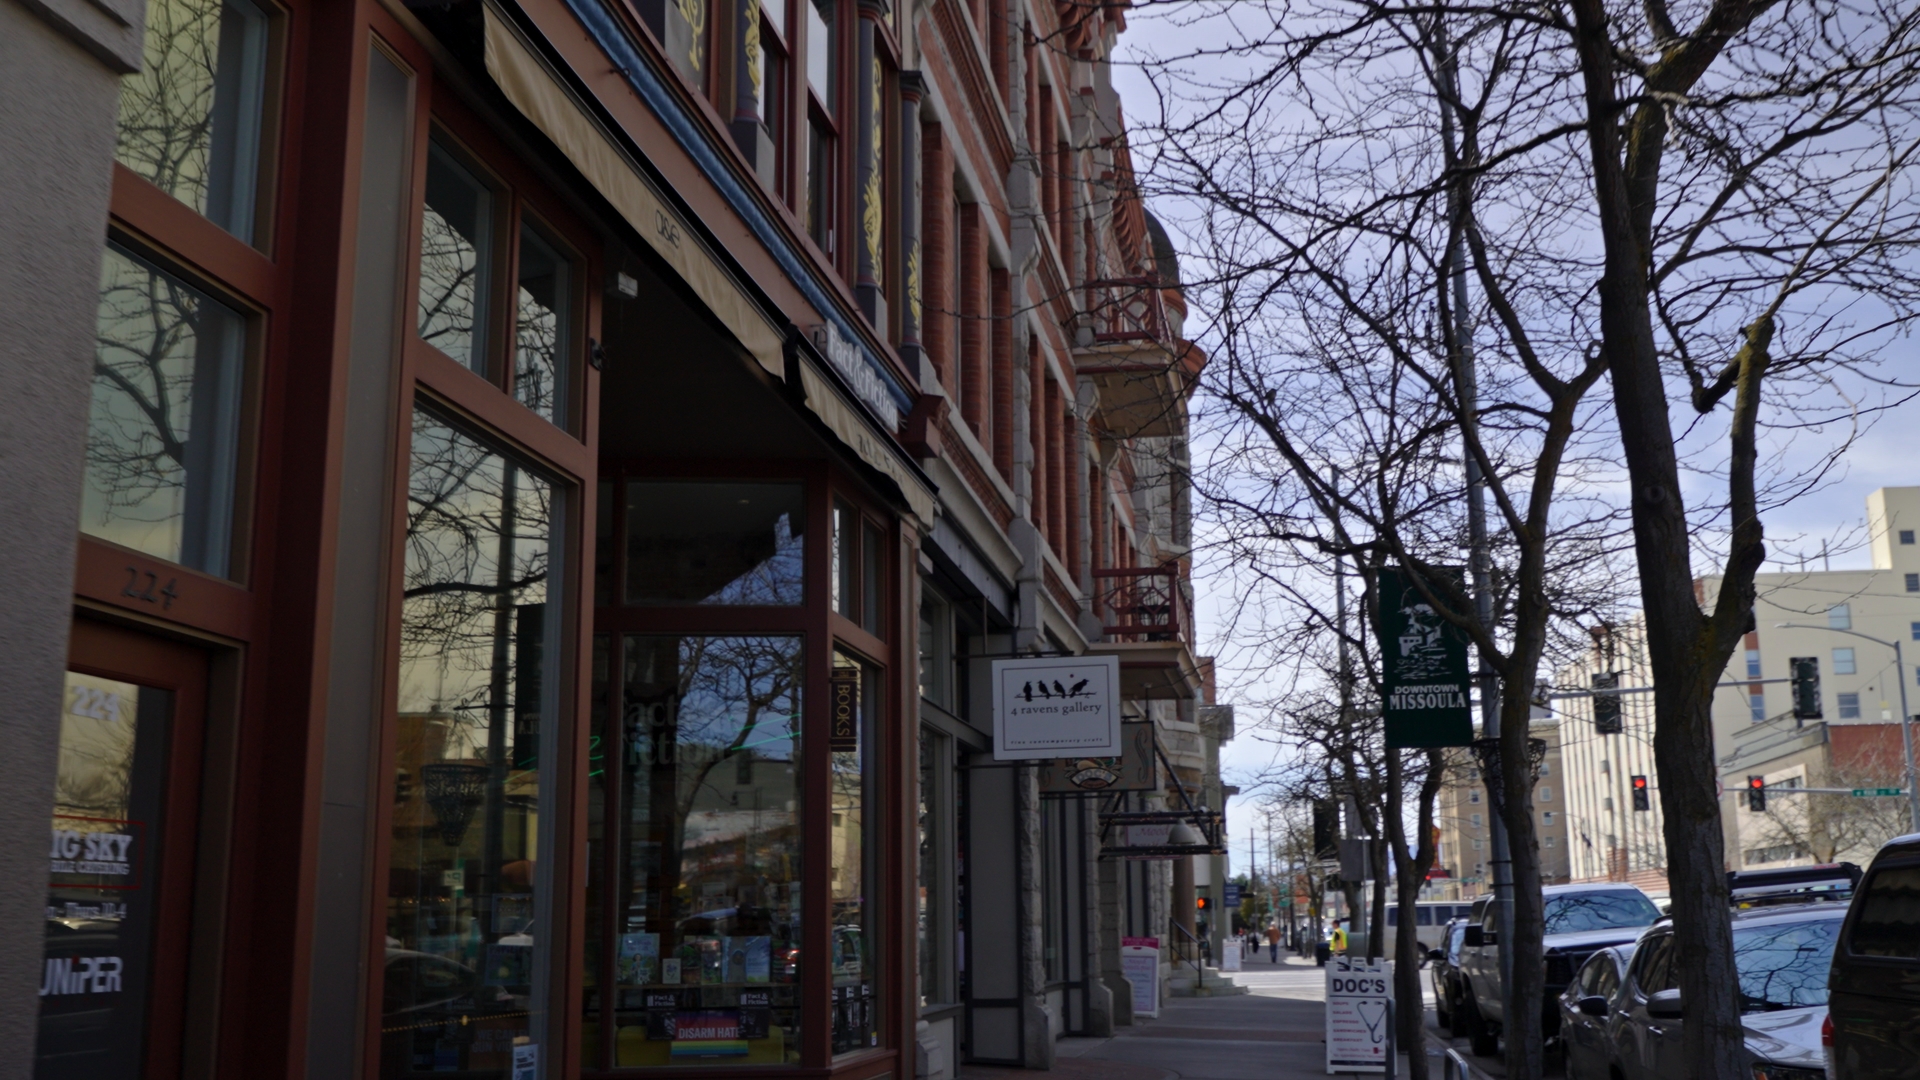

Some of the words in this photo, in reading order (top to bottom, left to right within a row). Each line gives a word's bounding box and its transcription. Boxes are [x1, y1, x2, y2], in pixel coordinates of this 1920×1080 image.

[827, 325, 853, 377] Fact
[853, 348, 864, 391] &
[864, 366, 899, 431] Fiction
[121, 565, 179, 611] 224
[71, 685, 120, 723] 224
[1389, 692, 1467, 711] MISSOULA
[1394, 683, 1460, 694] DOWNTOWN
[624, 693, 679, 727] act
[836, 684, 851, 737] BOOKS
[1010, 706, 1018, 717] 4
[1020, 705, 1059, 715] ravens
[1061, 702, 1103, 716] gallery
[49, 829, 80, 860] IG
[84, 831, 133, 863] SKY
[1332, 978, 1386, 993] DOC'S
[678, 1027, 715, 1039] DISARM
[717, 1026, 741, 1038] HATE
